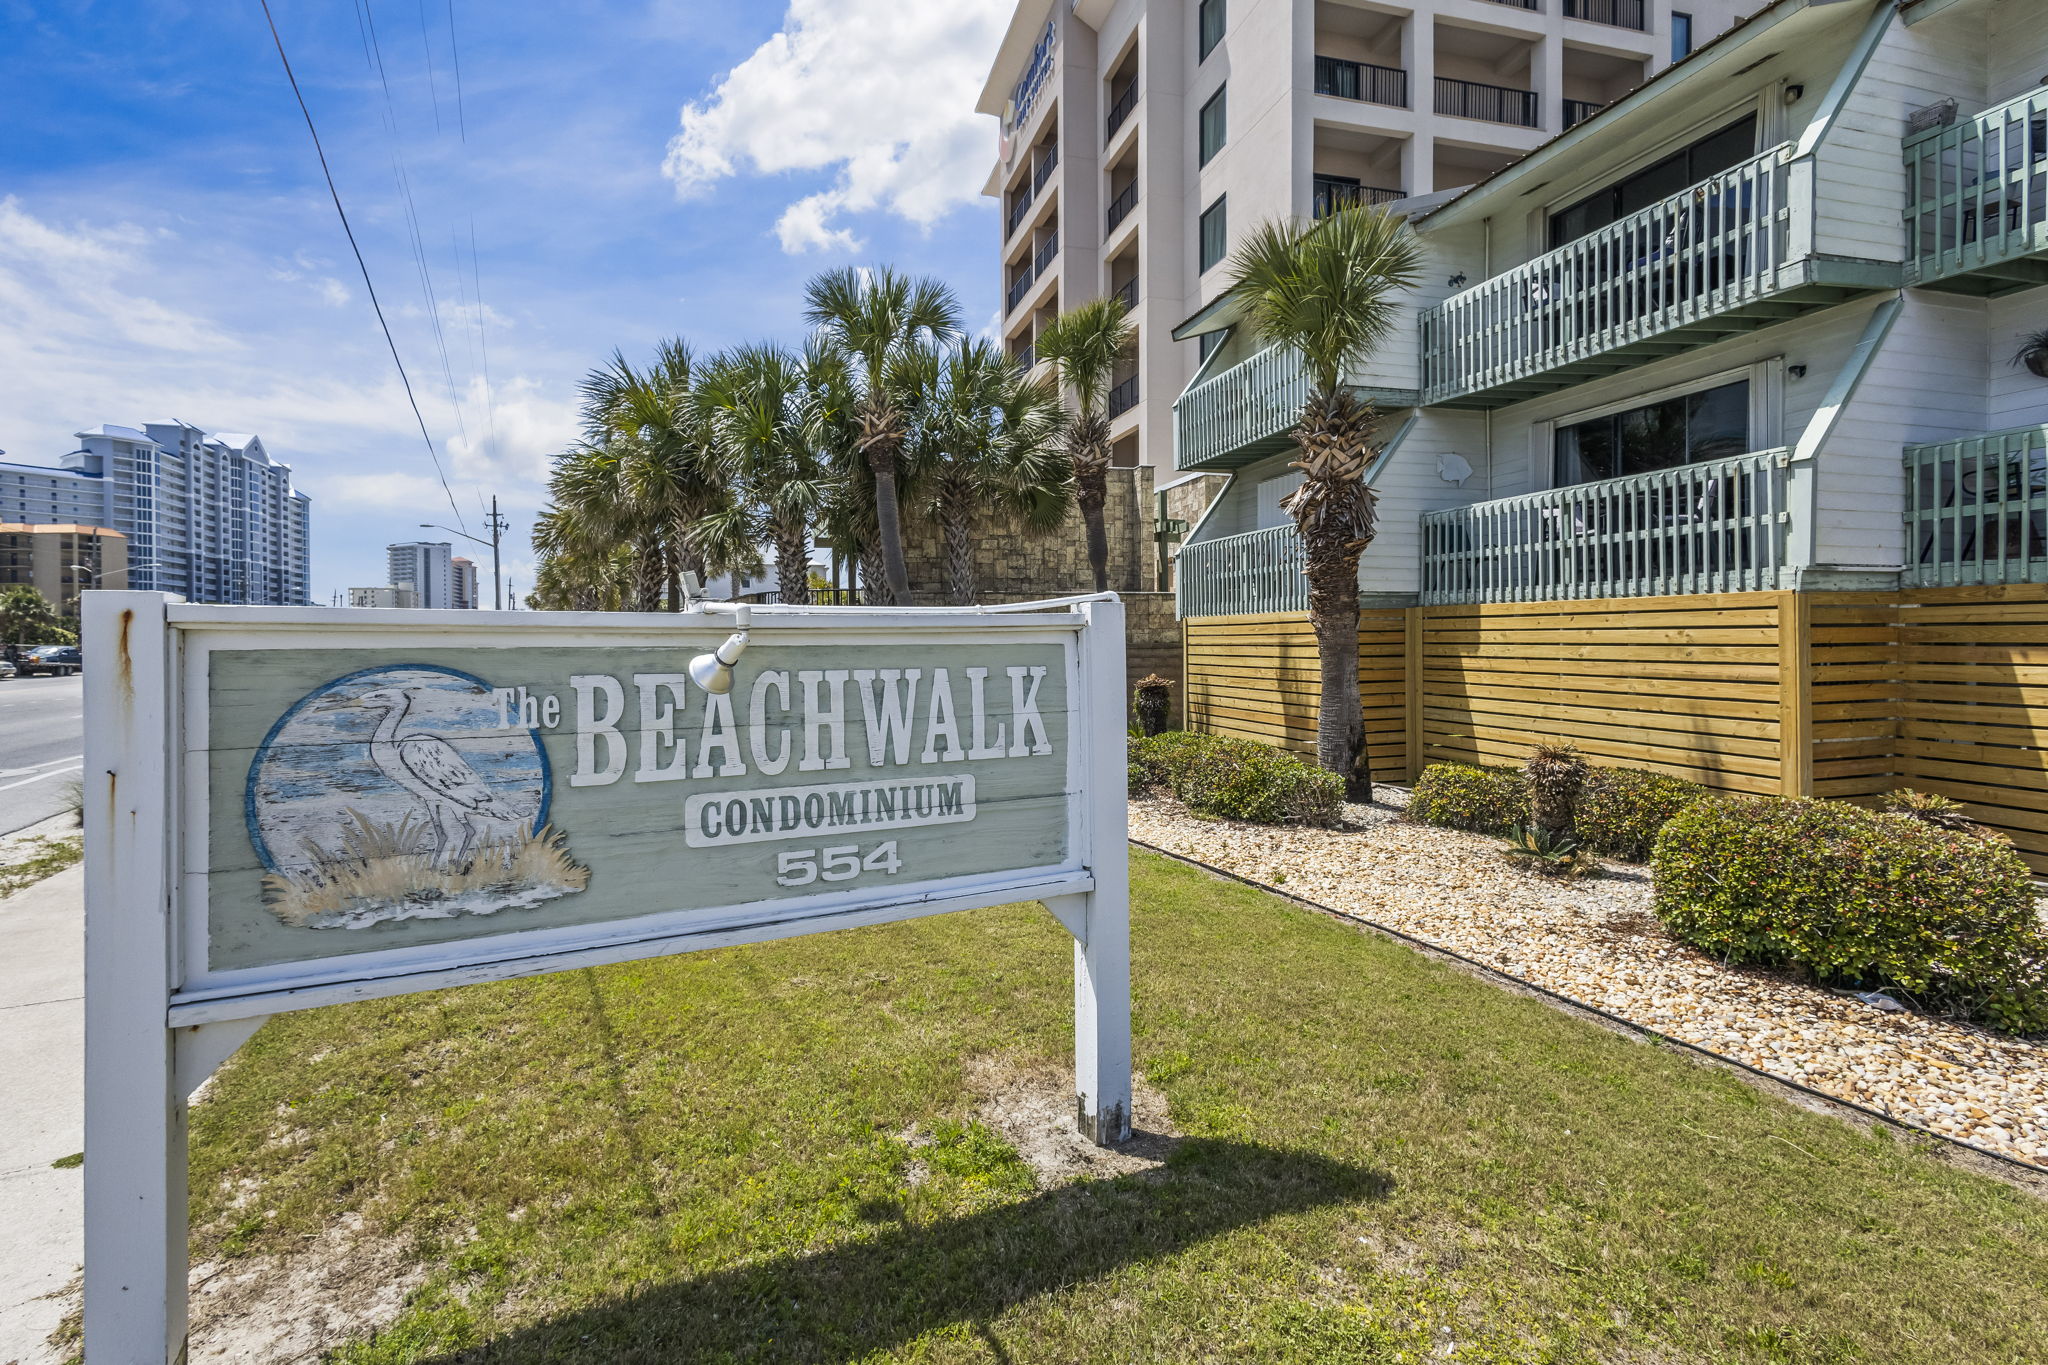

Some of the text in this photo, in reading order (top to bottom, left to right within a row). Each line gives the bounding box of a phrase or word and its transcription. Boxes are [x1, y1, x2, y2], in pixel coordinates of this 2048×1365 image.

[492, 664, 1053, 788] The BEACHWALK
[700, 781, 964, 839] CONDOMINIUM
[776, 840, 902, 887] 554
